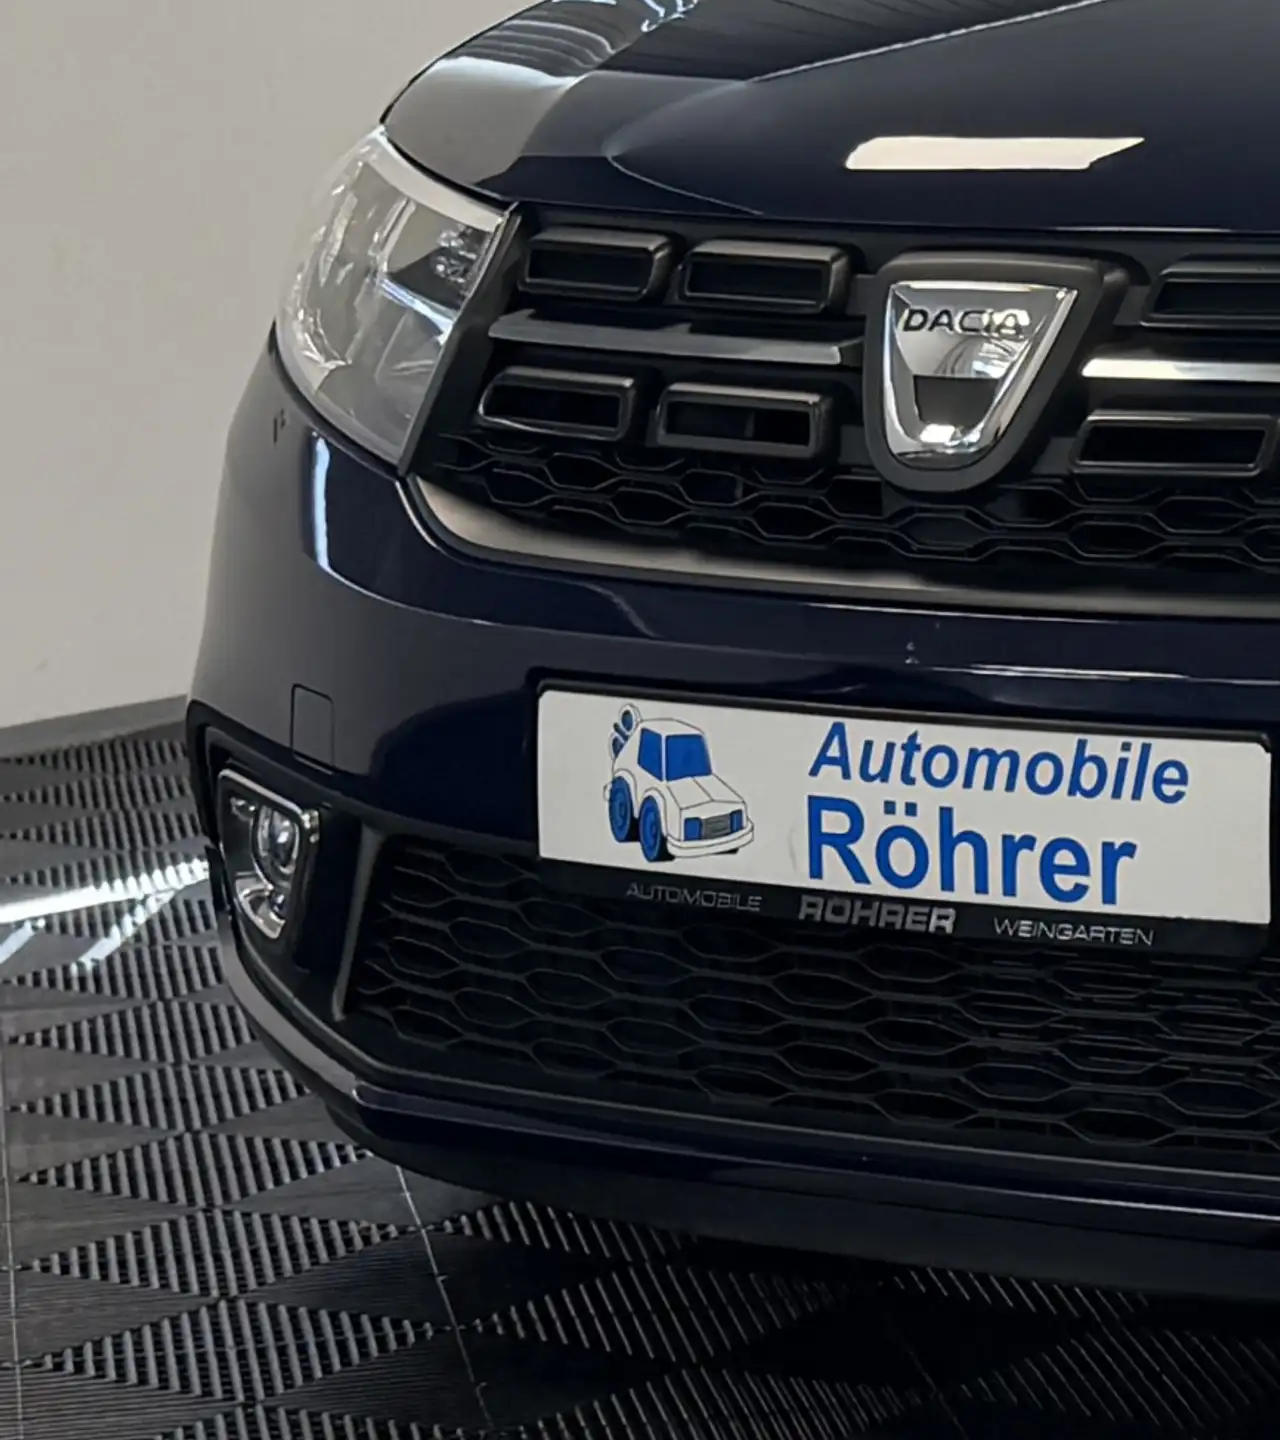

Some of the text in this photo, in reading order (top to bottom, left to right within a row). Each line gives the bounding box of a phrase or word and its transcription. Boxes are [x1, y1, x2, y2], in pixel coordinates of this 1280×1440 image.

[902, 308, 1026, 337] DACIA
[808, 722, 1189, 804] Automobile
[807, 796, 1136, 905] Röhrer
[626, 882, 762, 912] AUTOMOBILE
[994, 917, 1154, 945] WEINGARTEN
